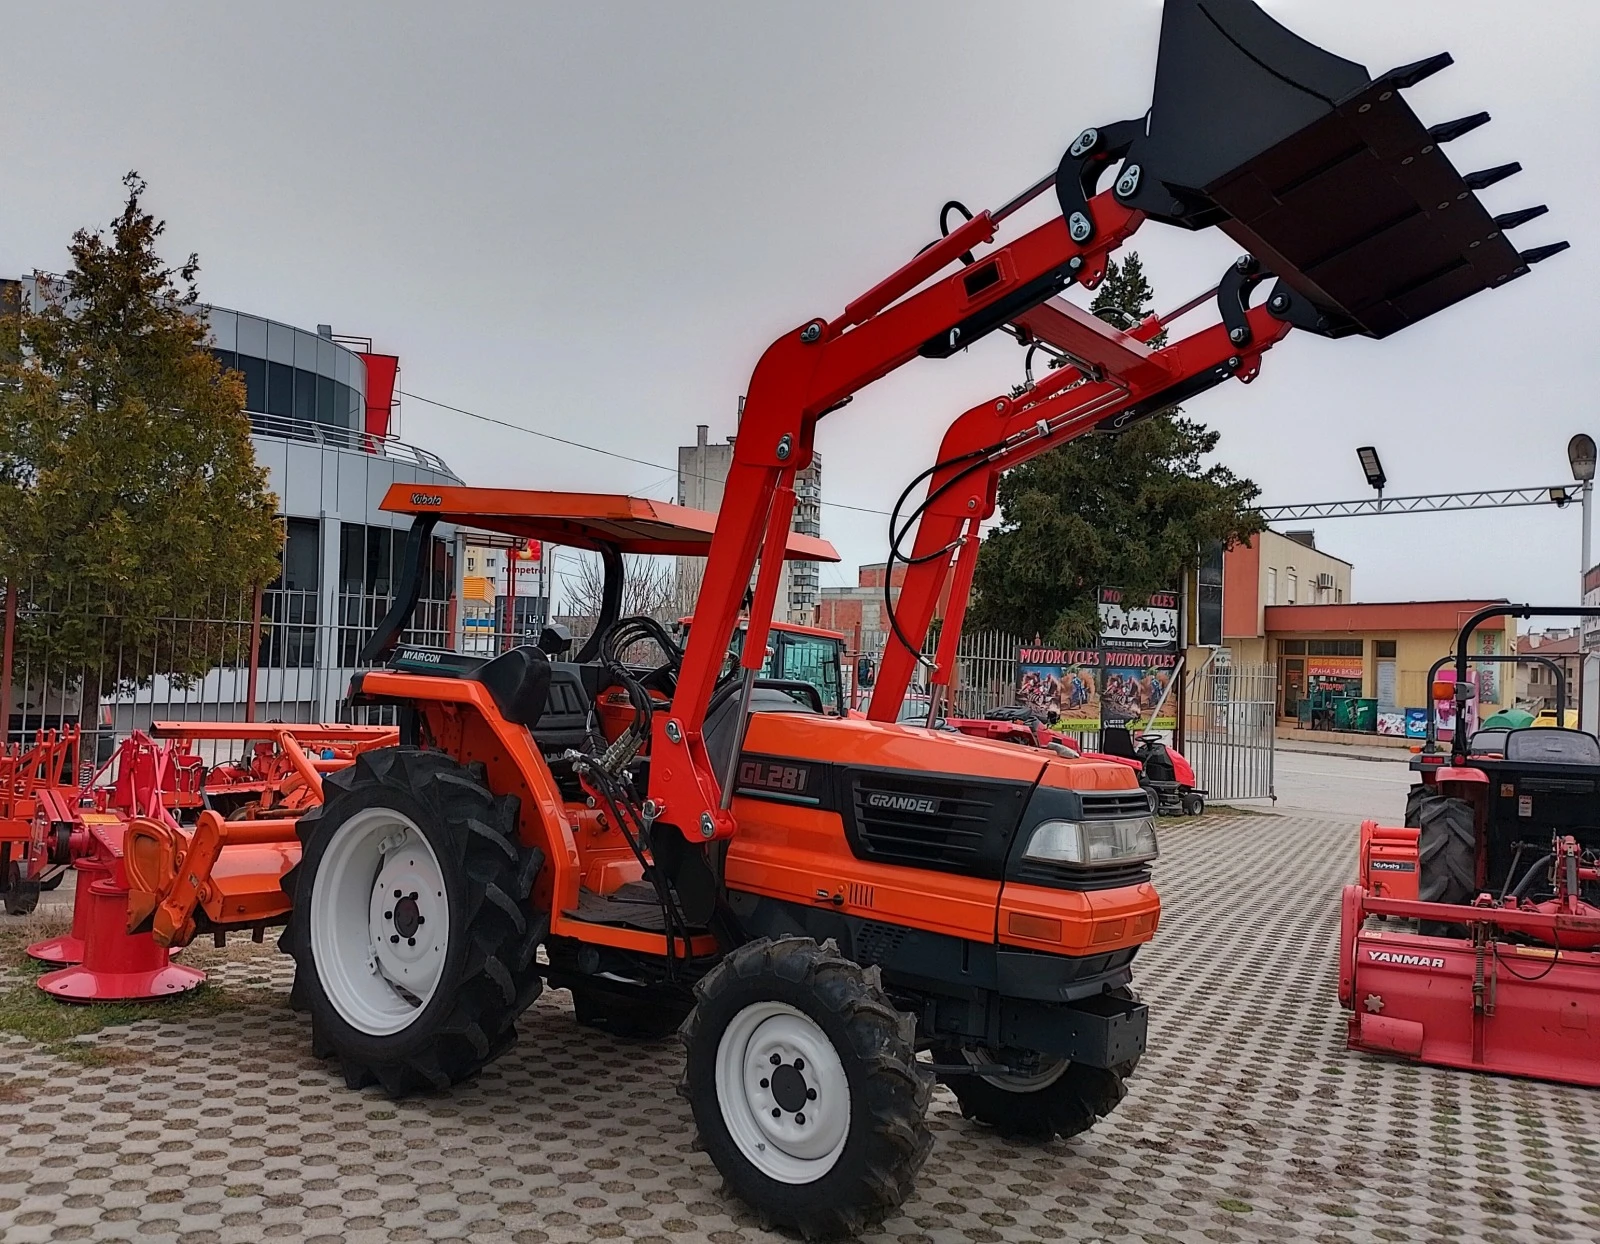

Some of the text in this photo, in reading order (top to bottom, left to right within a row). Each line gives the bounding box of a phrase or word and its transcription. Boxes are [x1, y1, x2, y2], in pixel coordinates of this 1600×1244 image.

[411, 493, 443, 506] Kubota
[1019, 648, 1100, 666] MOTORCYCLES
[1105, 652, 1176, 668] MOTORCYCLES
[1310, 667, 1331, 675] ХРАНА
[739, 761, 807, 791] GL281
[869, 793, 935, 813] GRANDEL
[1368, 951, 1444, 968] YANMAR
